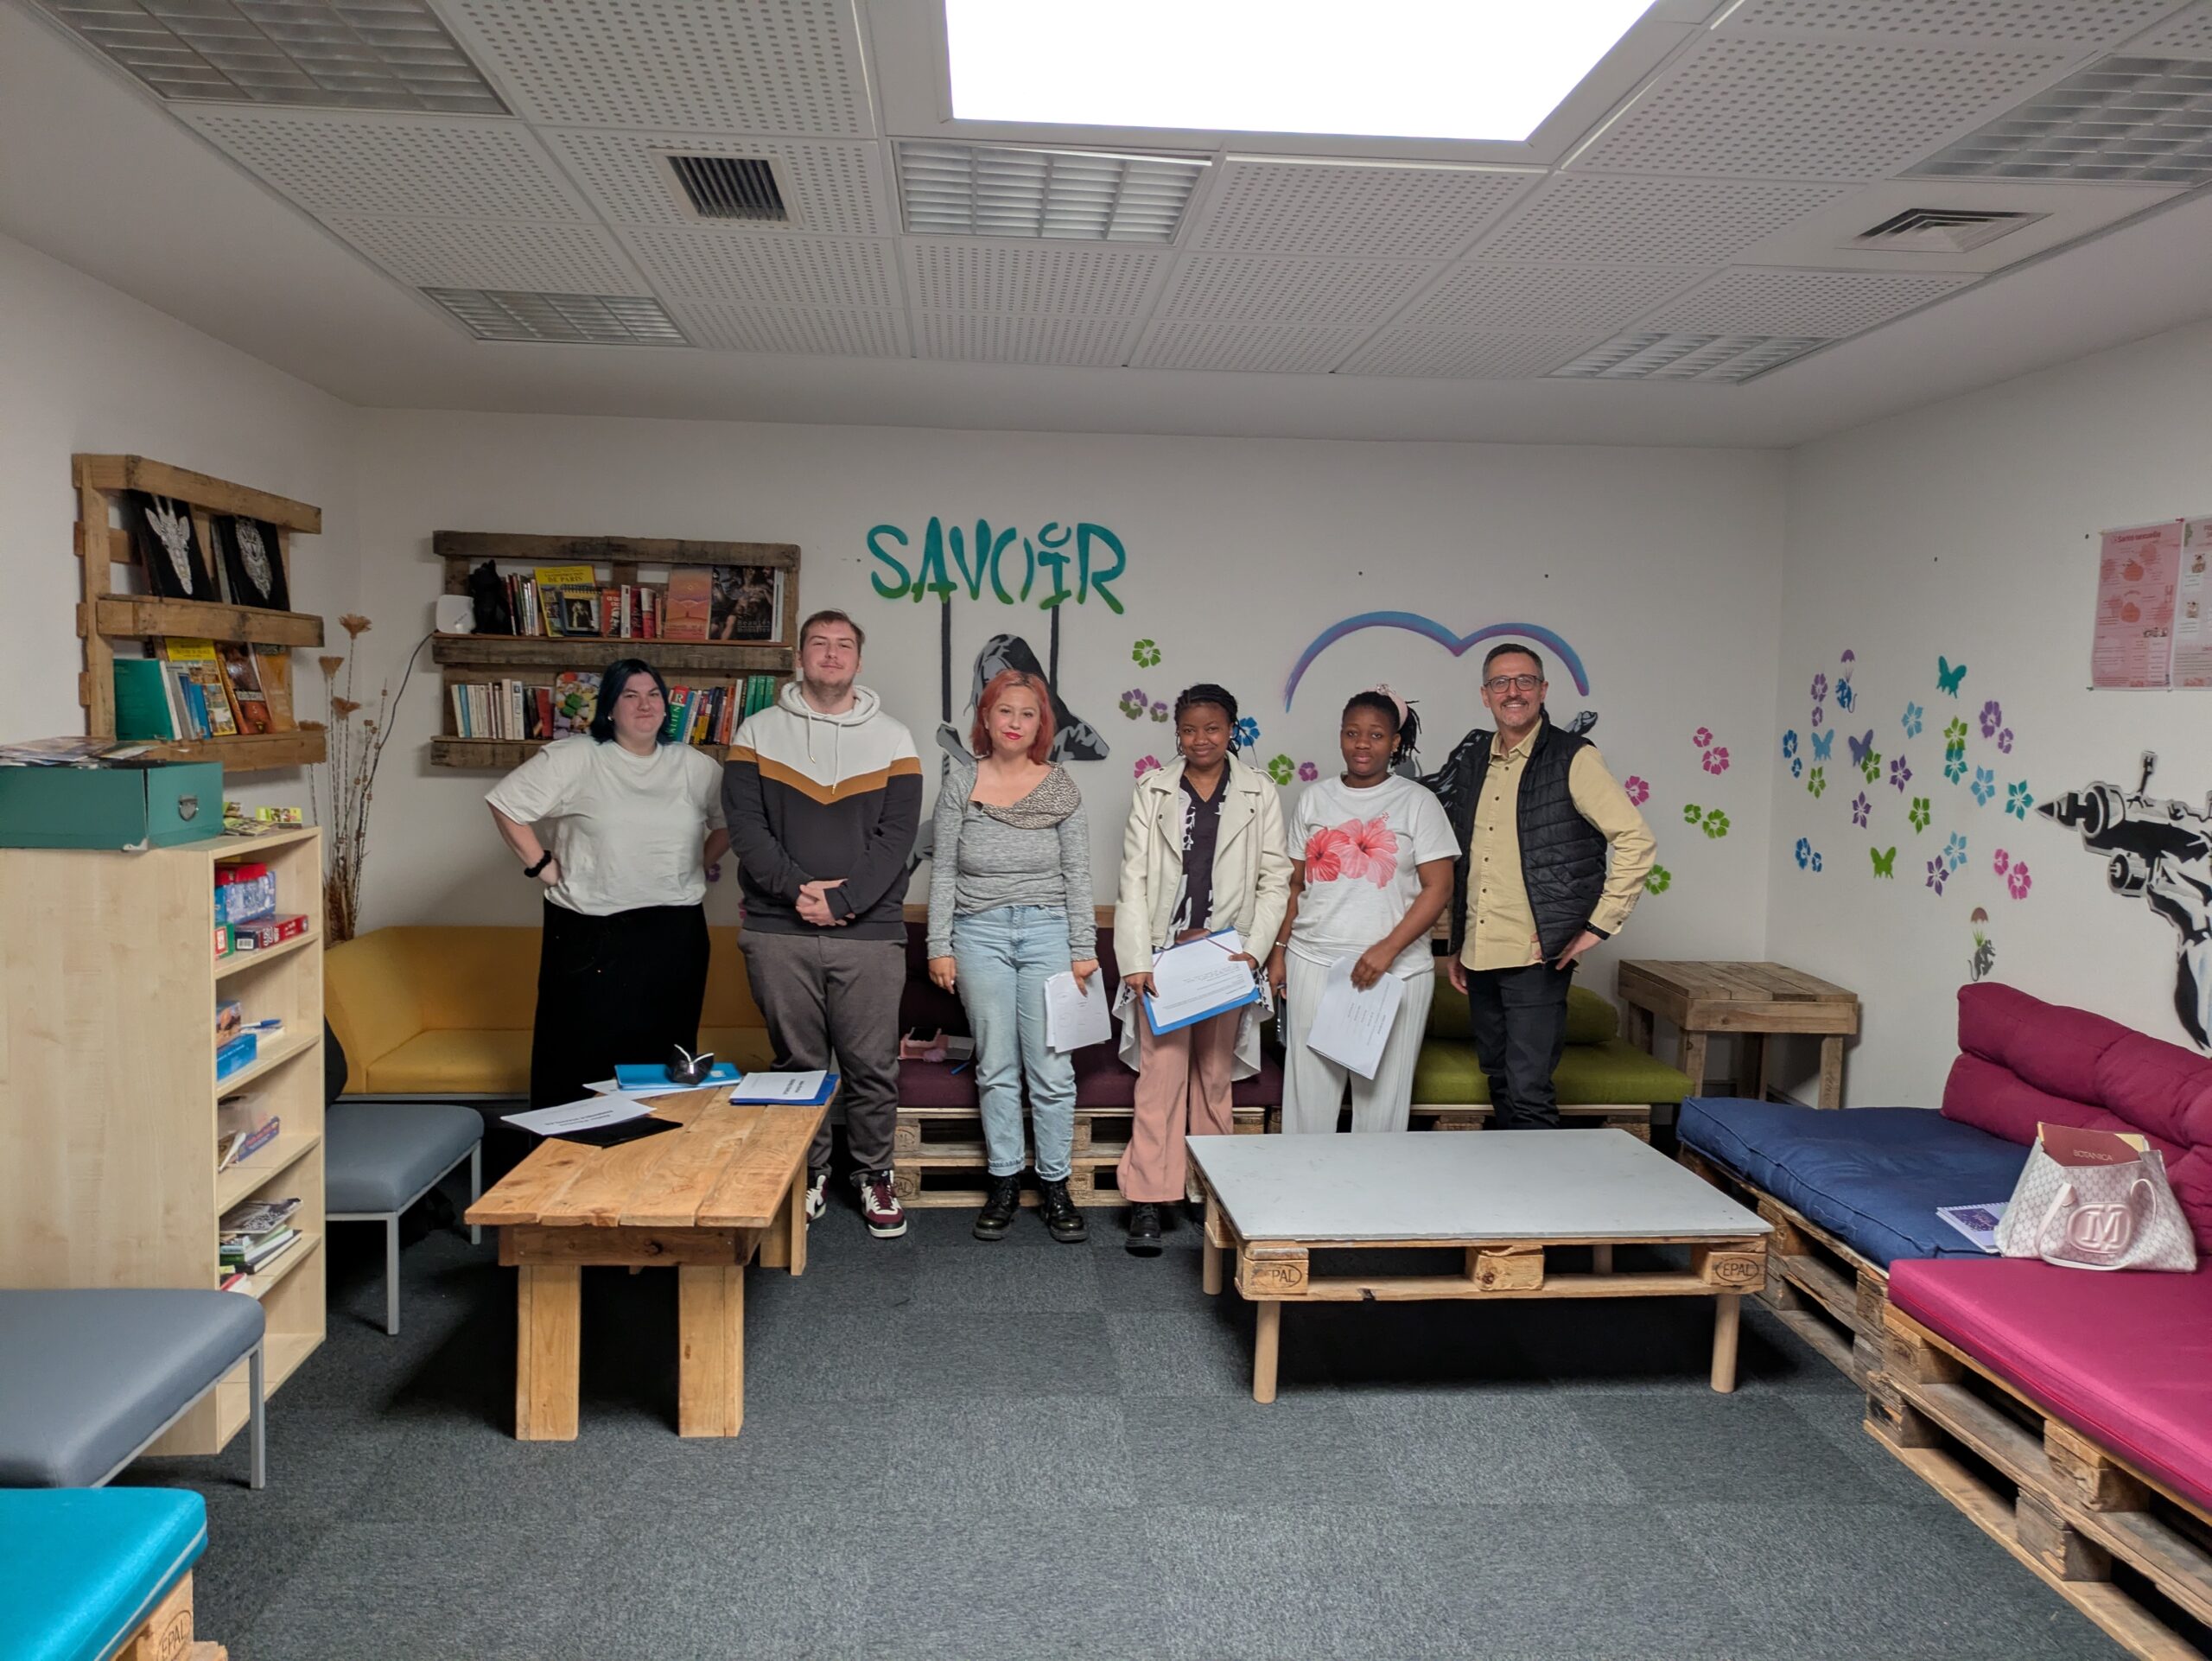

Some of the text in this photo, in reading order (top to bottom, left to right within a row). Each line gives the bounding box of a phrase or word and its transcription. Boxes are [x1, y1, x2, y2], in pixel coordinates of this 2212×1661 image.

[867, 516, 1126, 614] SAVOIR
[2073, 1149, 2114, 1161] BOTANICA
[1268, 1269, 1295, 1283] PAL
[1723, 1263, 1753, 1276] EPAL
[162, 1619, 188, 1660] EPAL
